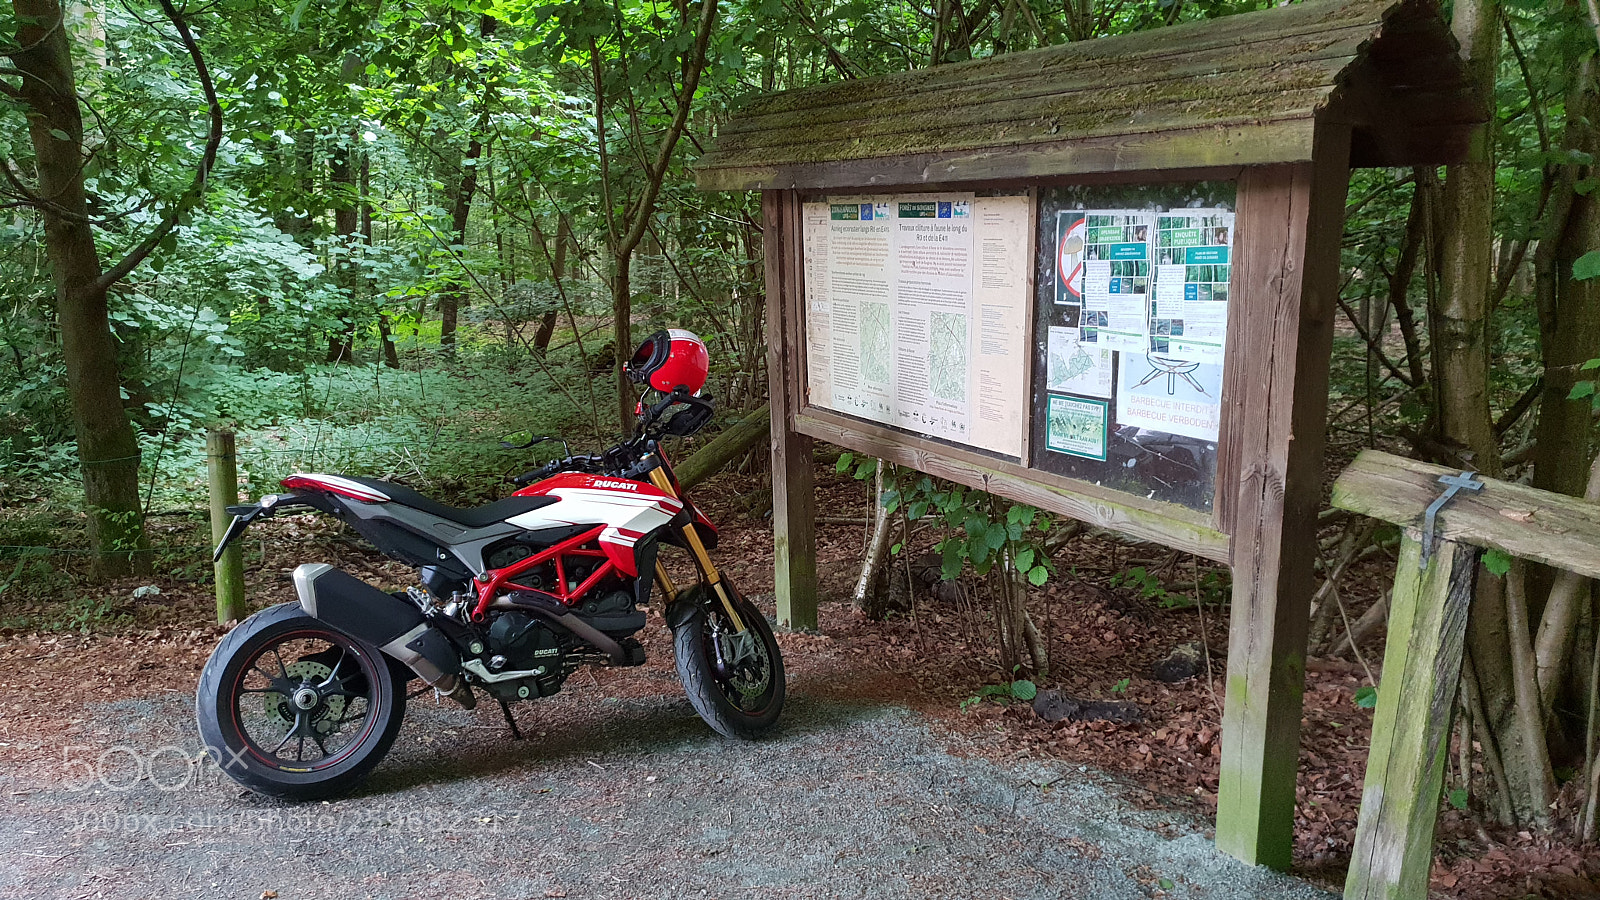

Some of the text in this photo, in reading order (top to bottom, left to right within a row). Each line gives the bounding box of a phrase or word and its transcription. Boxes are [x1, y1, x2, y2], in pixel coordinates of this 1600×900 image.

[899, 203, 911, 211] FORÊT
[899, 223, 914, 232] Travaux
[915, 223, 929, 232] clôture
[934, 223, 946, 232] faune
[952, 224, 960, 234] long
[1175, 231, 1197, 239] ENQUÊTE
[1174, 238, 1198, 246] PUBLIQUE
[1065, 400, 1082, 409] TOUCHEZ
[1131, 395, 1210, 415] BARBECUE INTERDIT
[1127, 407, 1213, 429] BARBECUE VERBODEN
[593, 480, 638, 491] DUCATI
[534, 648, 558, 656] DUCATI
